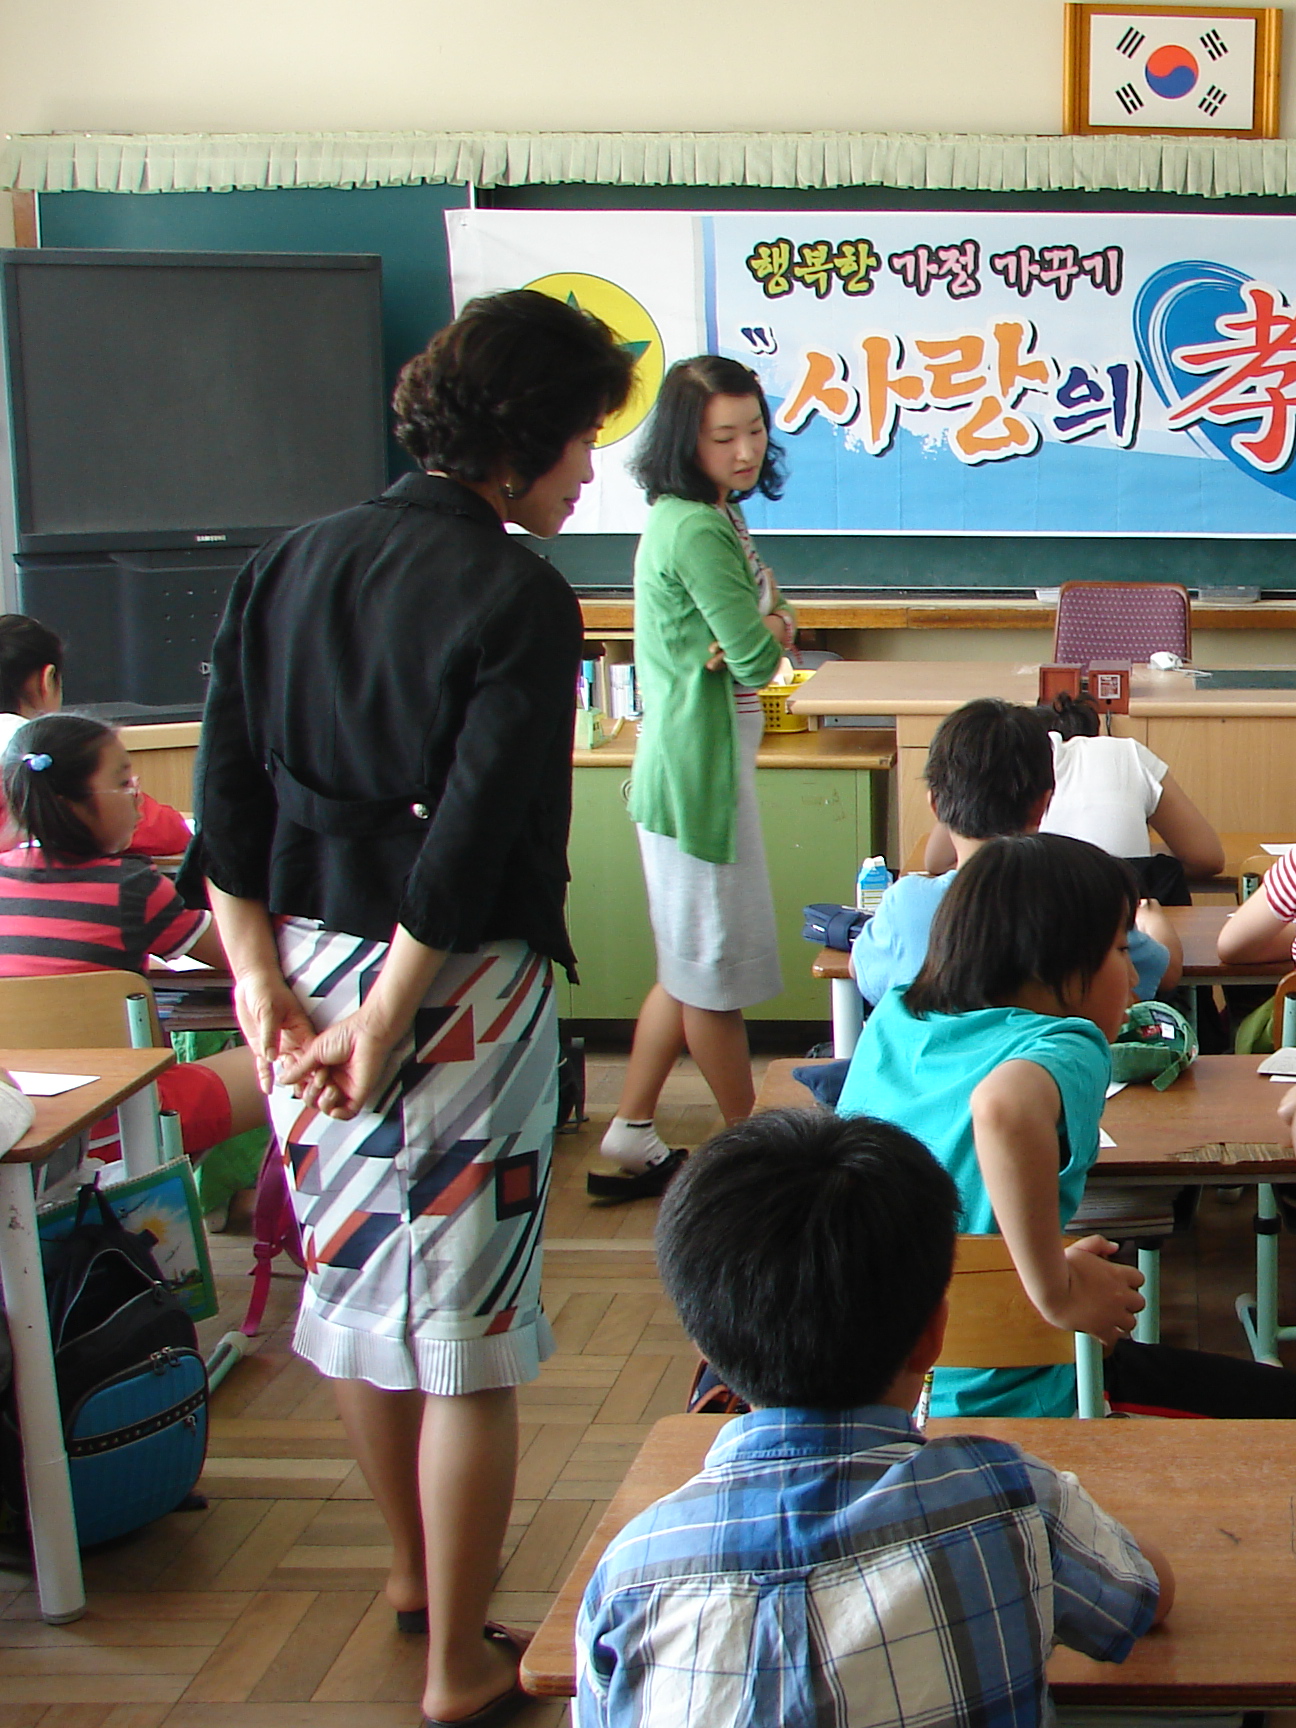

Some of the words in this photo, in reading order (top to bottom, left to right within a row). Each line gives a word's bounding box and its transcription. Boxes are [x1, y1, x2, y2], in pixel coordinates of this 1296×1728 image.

[747, 238, 882, 298] 행복한
[890, 240, 981, 298] 가정
[991, 246, 1124, 298] 가꾸기
